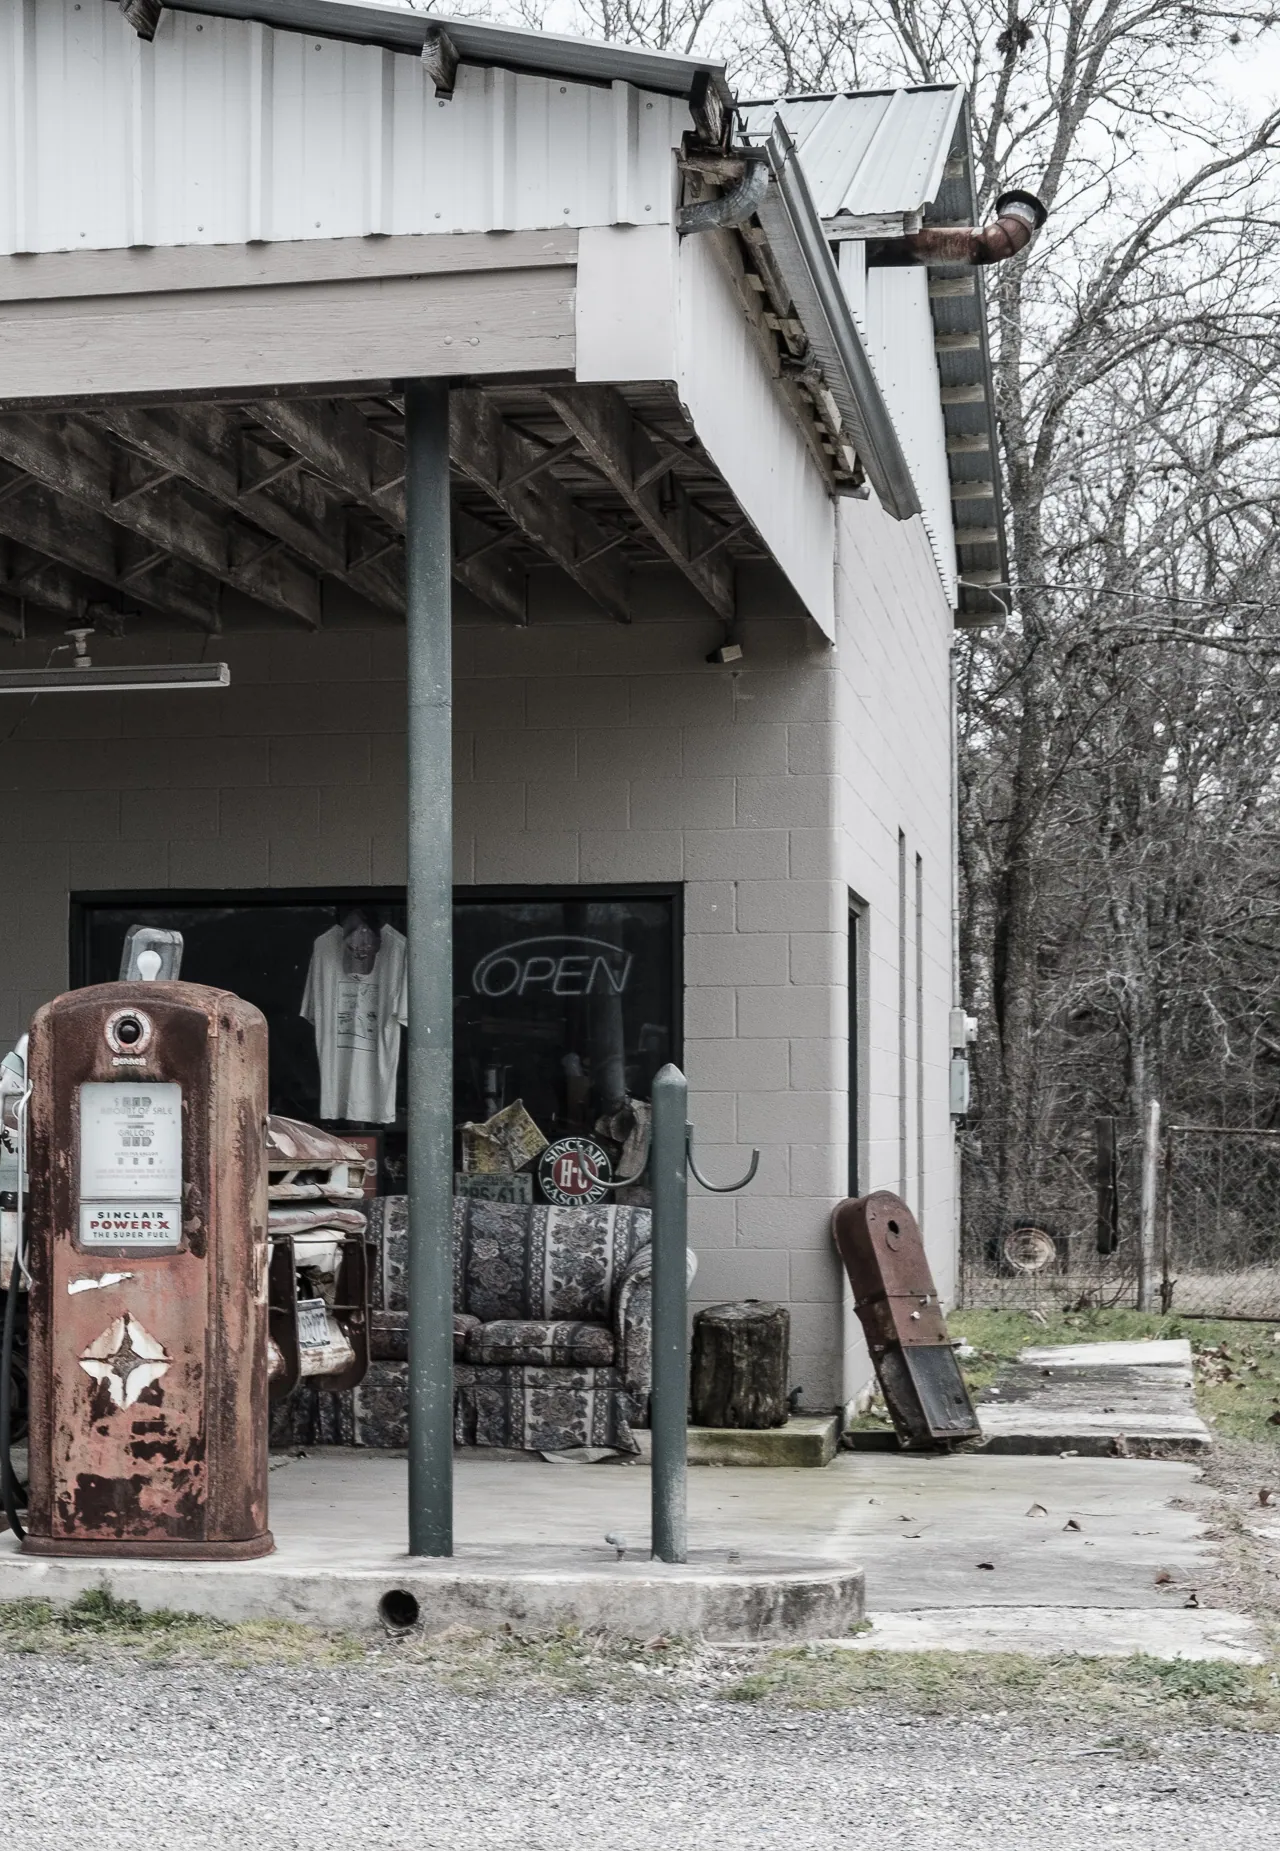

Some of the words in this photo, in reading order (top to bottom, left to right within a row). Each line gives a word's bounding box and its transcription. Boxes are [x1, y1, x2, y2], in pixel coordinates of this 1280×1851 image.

[481, 956, 634, 996] OPEN
[117, 1129, 155, 1137] GALLONS
[542, 1176, 606, 1206] GASOLIN
